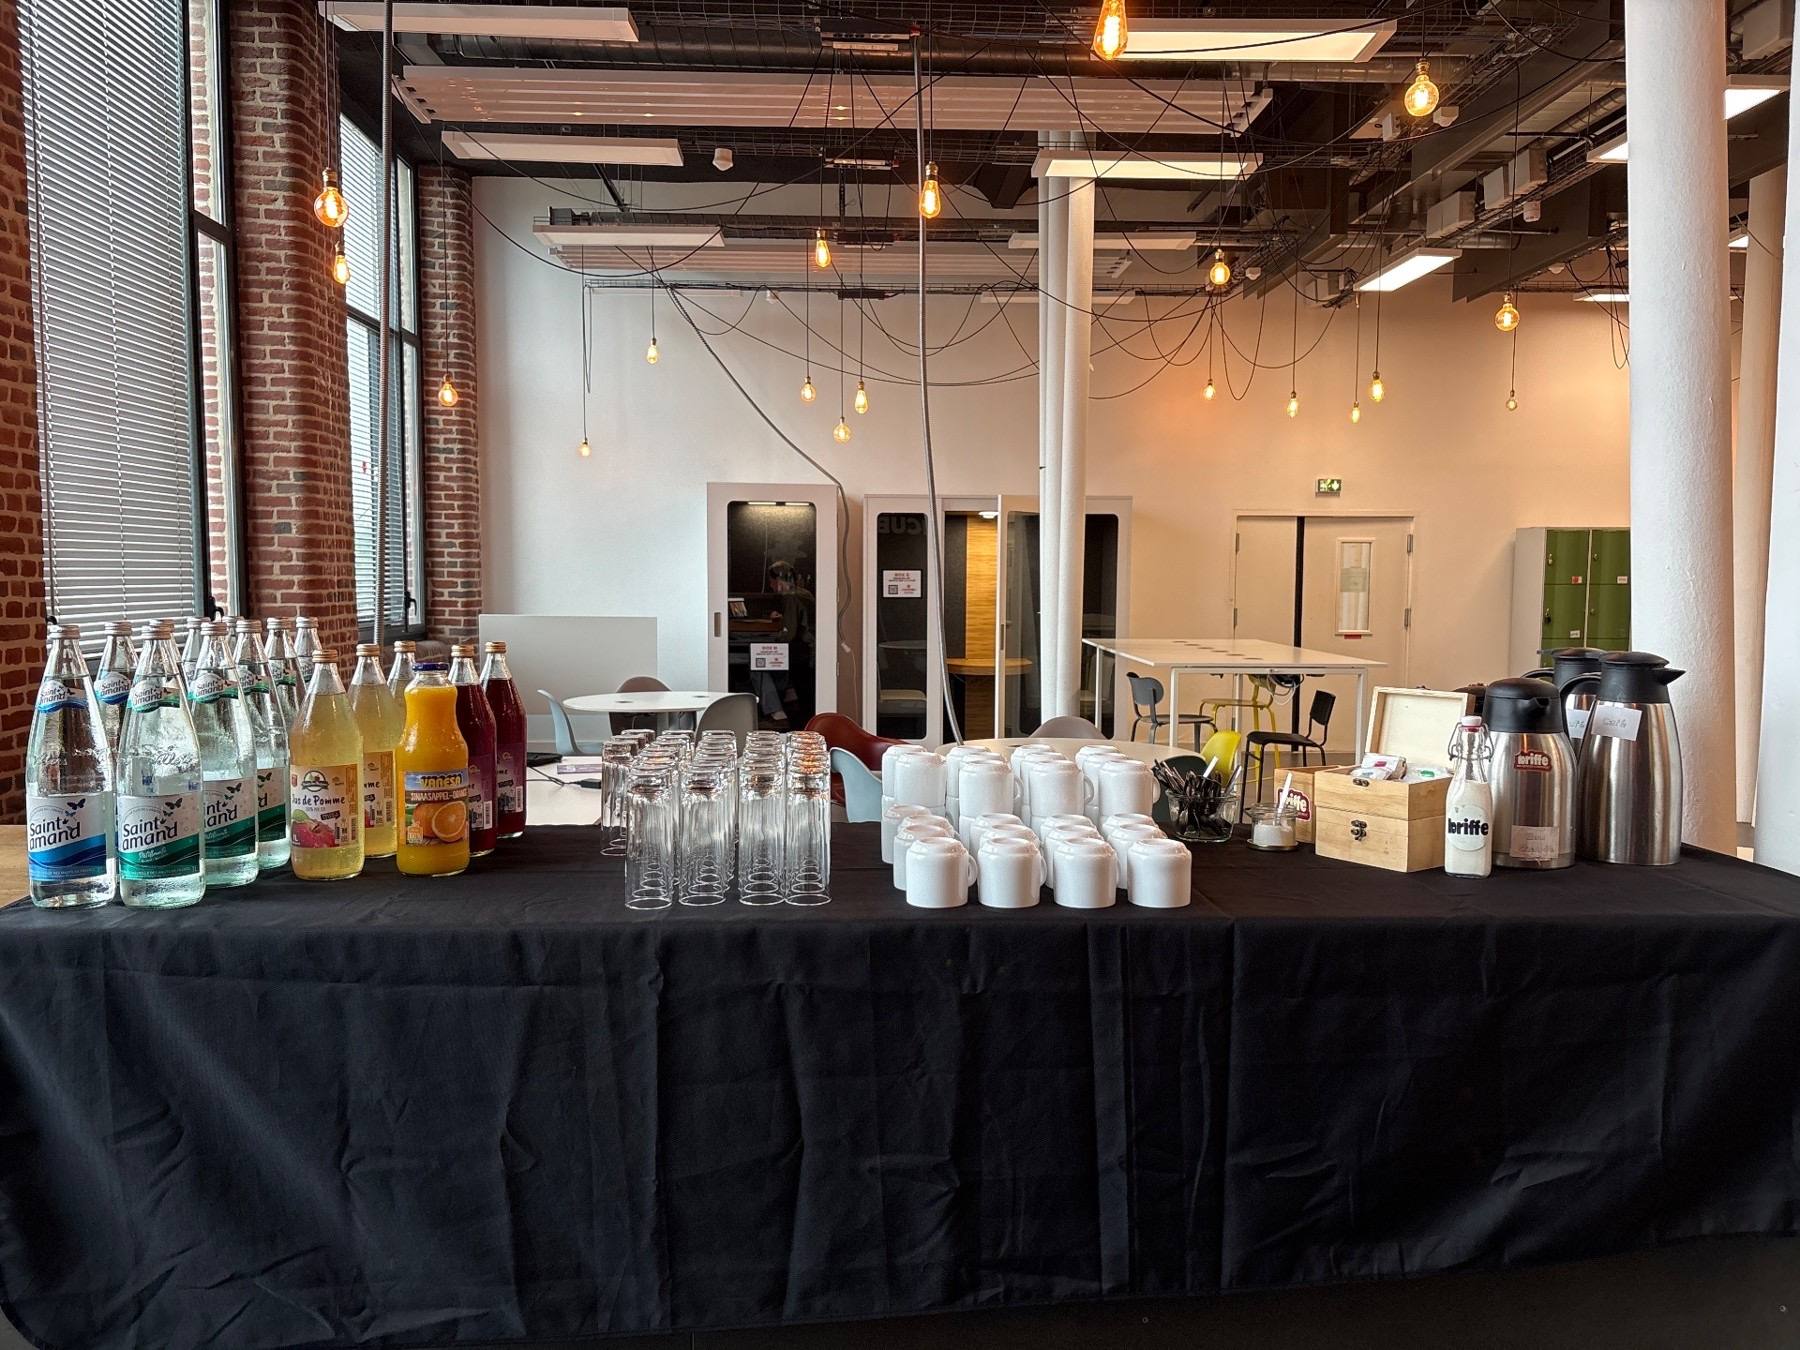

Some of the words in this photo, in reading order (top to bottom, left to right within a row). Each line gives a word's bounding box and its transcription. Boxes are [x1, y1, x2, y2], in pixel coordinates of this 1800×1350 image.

[1517, 752, 1549, 766] briffe
[302, 794, 312, 806] de
[313, 794, 346, 806] Pomme
[29, 816, 62, 837] Saint
[29, 821, 81, 851] amand
[122, 820, 178, 851] amand
[123, 816, 160, 838] Saint
[1448, 817, 1489, 836] briffe
